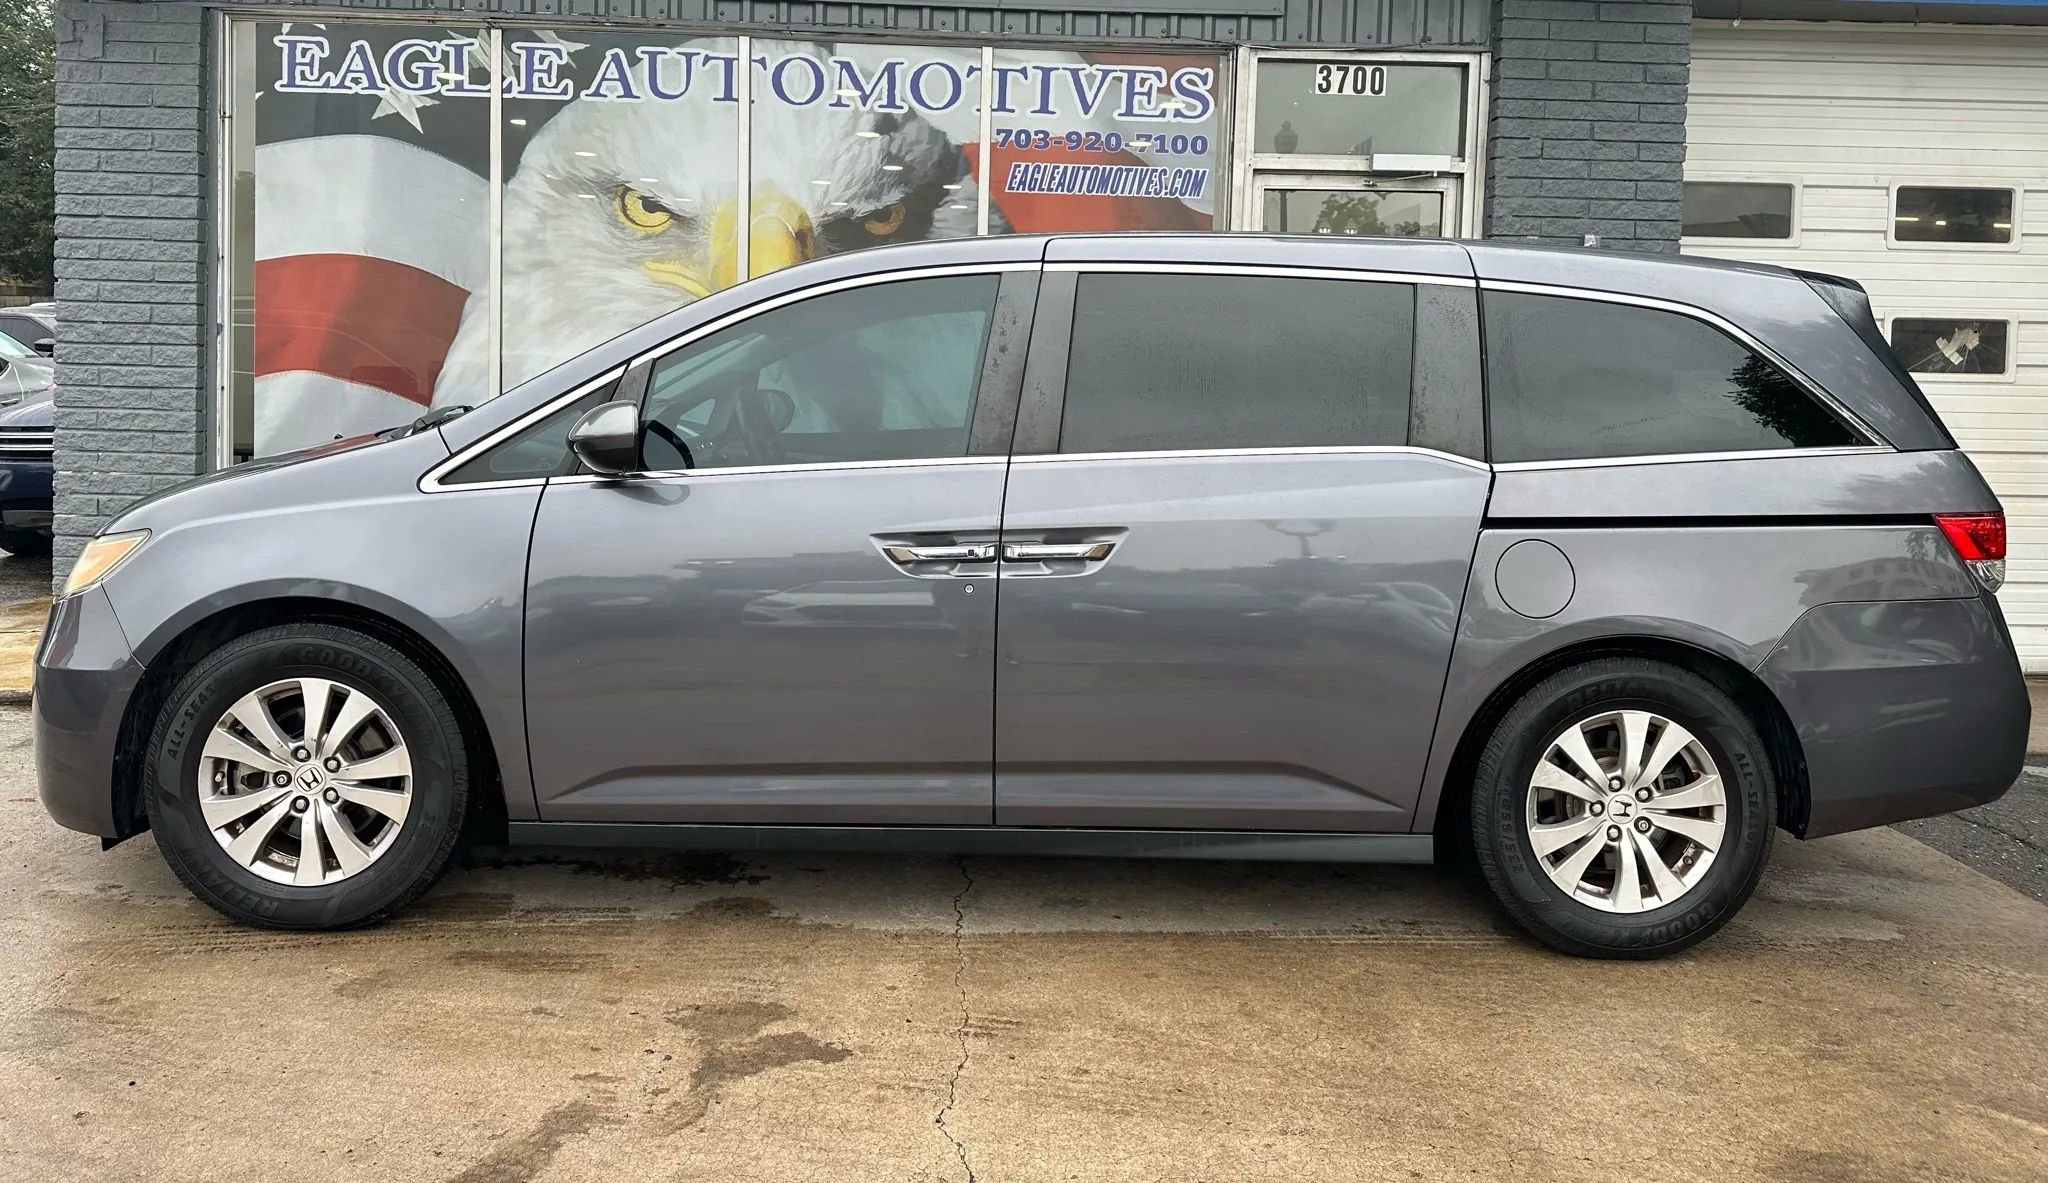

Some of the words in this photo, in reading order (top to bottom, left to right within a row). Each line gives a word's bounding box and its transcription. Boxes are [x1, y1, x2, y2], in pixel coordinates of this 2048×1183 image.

[277, 37, 571, 98] EAGLE
[585, 46, 1213, 121] AUTOMOTIVES
[1317, 64, 1385, 96] 3700
[995, 128, 1209, 156] 703-920-7100
[1006, 163, 1209, 198] EAGLEAUTOMOTIVES.COM
